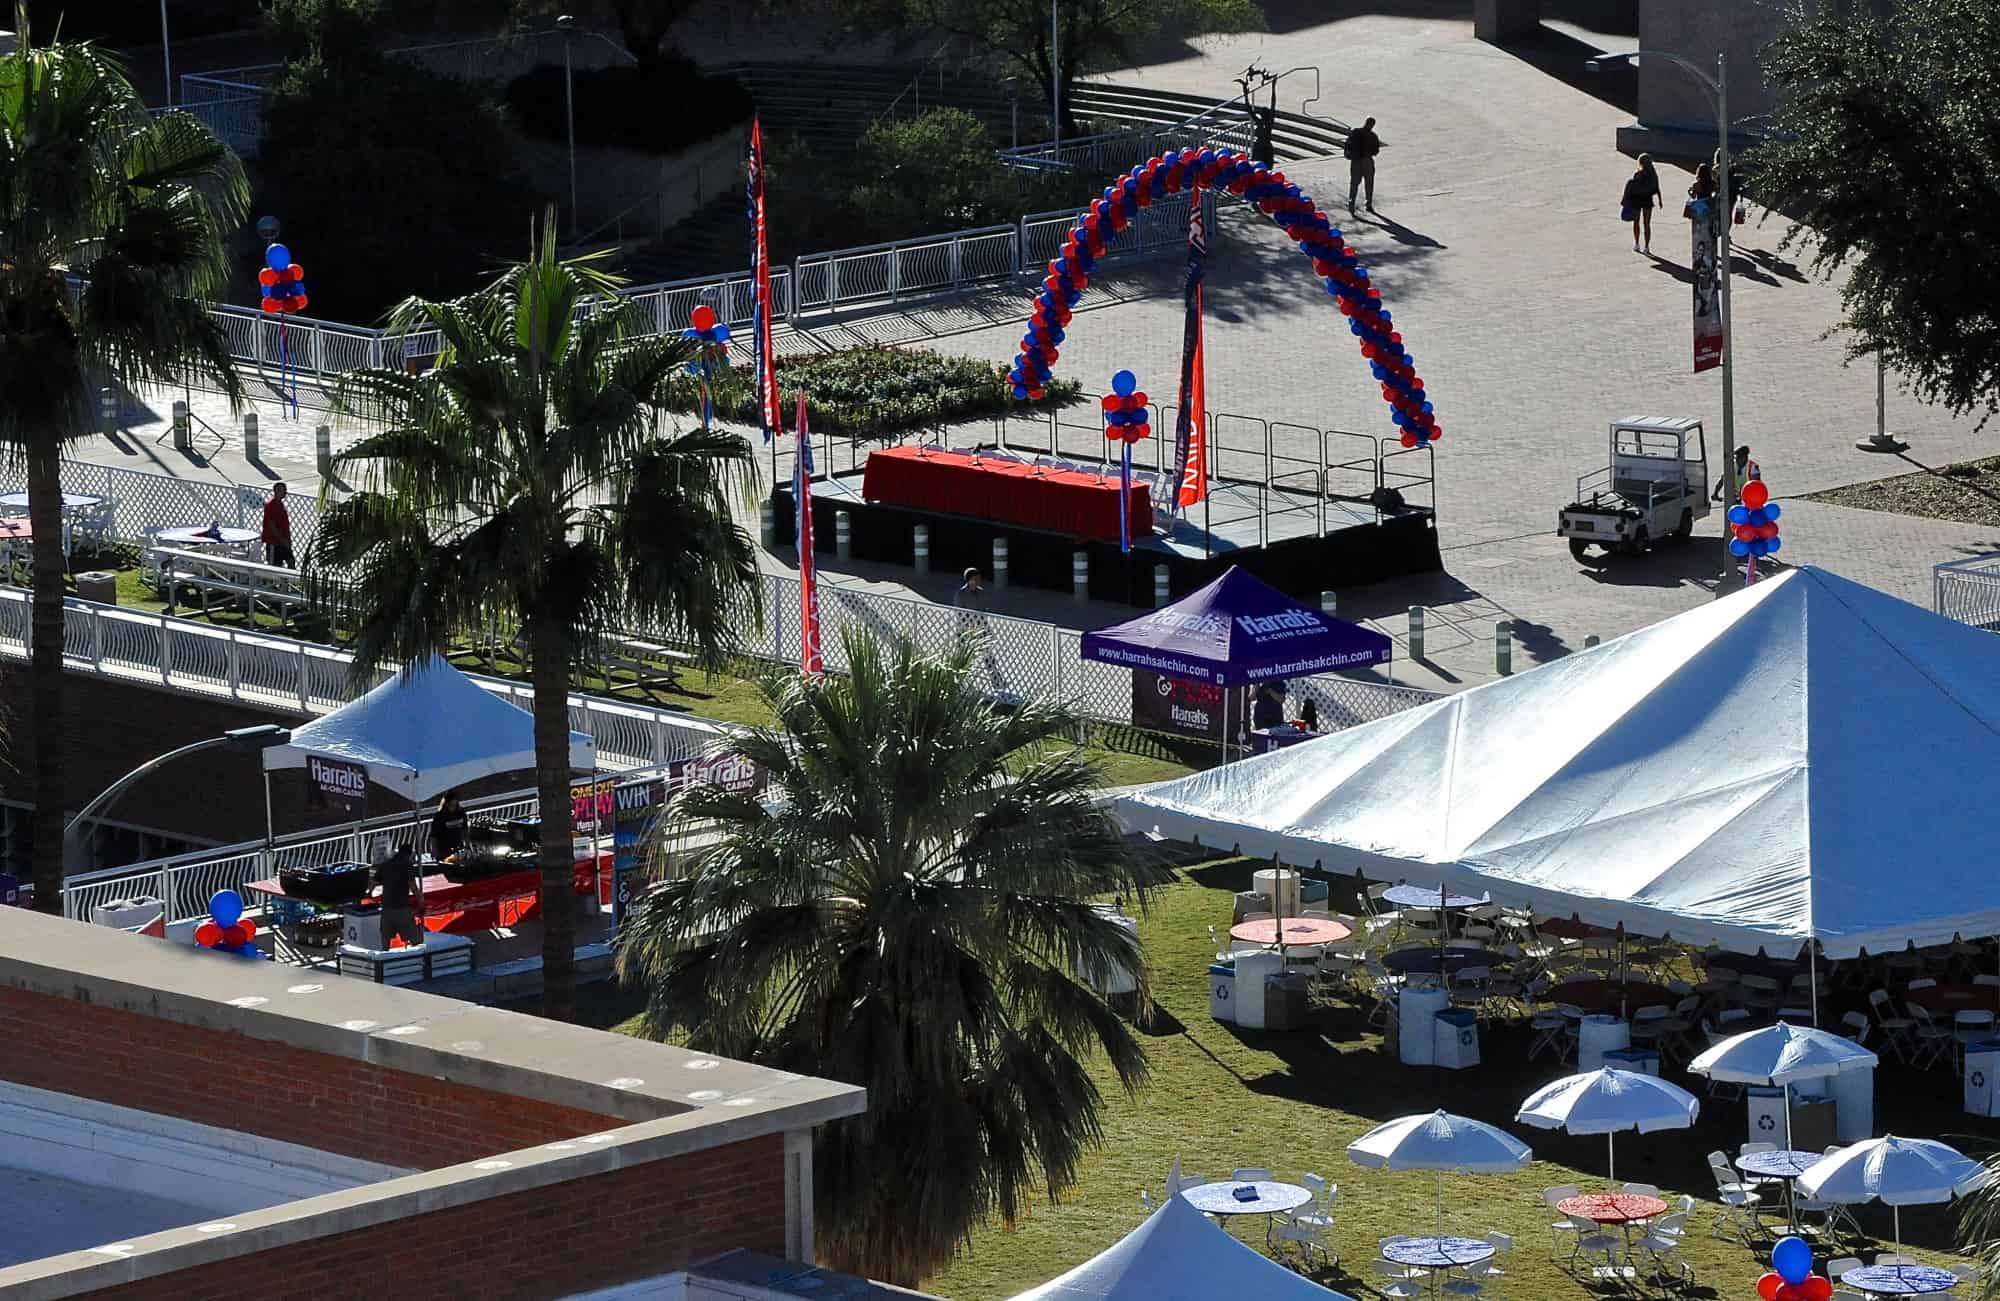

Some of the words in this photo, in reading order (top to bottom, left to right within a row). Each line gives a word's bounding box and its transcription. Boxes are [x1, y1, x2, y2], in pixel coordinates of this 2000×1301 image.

[1098, 646, 1209, 678] www.harrahsakchin.com
[1247, 649, 1373, 678] www.harrahsakchin.com
[617, 784, 651, 810] WIN
